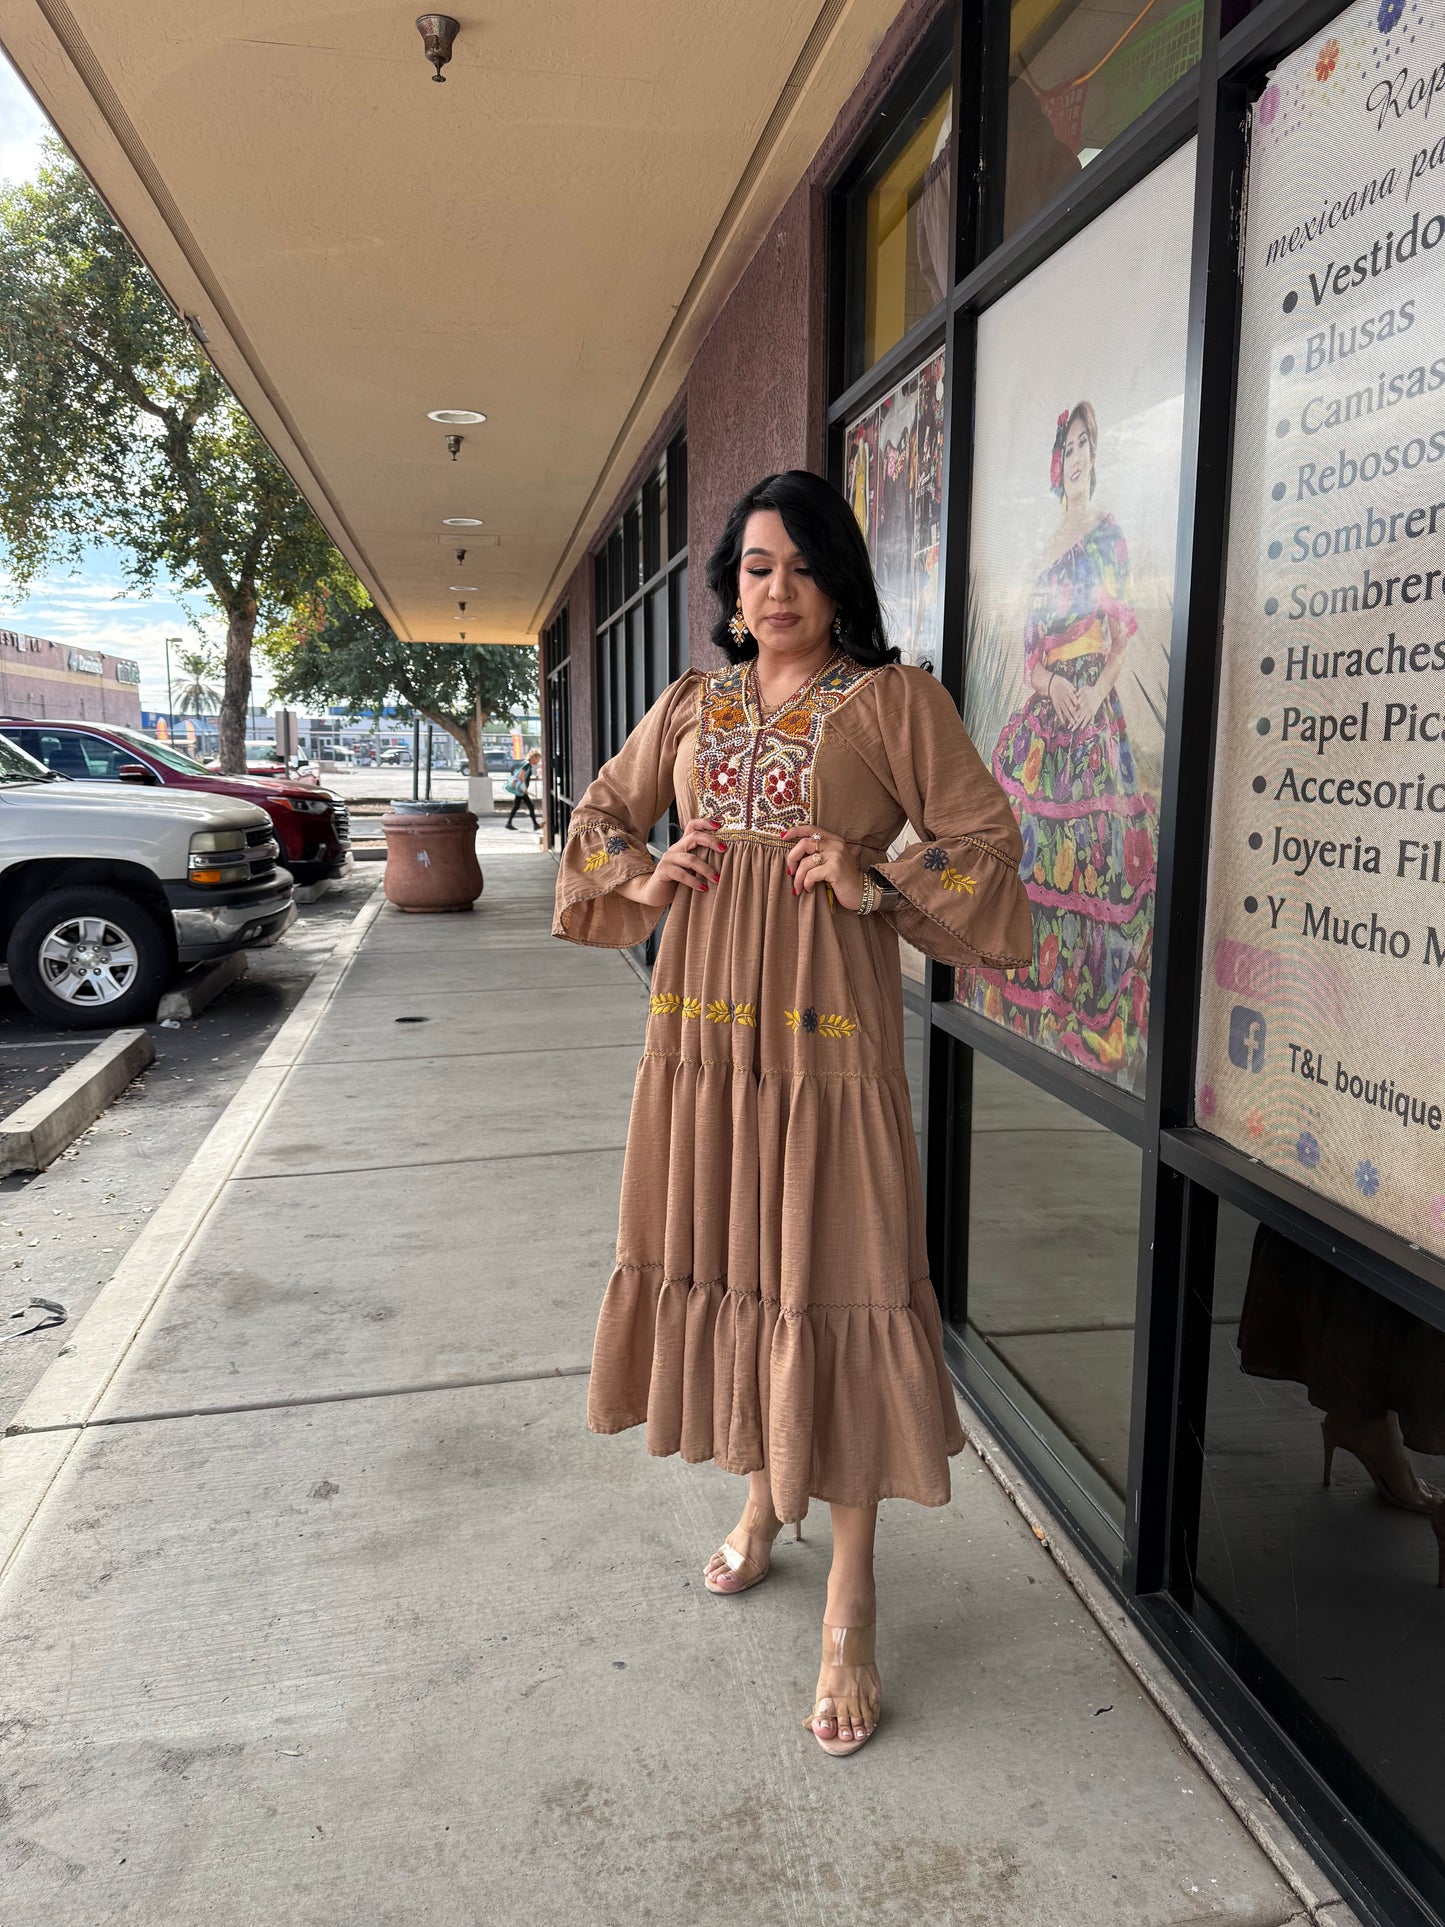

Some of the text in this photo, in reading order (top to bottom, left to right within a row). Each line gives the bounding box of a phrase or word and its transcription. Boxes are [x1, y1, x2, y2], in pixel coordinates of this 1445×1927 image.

[1265, 167, 1401, 267] mexicana
[1309, 211, 1445, 306] Vestido
[1304, 299, 1415, 375] Blusas
[1300, 357, 1445, 435] Camisas
[1296, 430, 1445, 500] Rebosos
[1288, 569, 1445, 620] Sombrer
[1285, 632, 1445, 681] Huraches
[1281, 702, 1445, 755] Papel Pic
[1271, 826, 1445, 883] Joyeria Fil
[1267, 895, 1286, 929] Y
[1301, 902, 1410, 958] Mucho
[1289, 1043, 1442, 1131] T&L boutique
